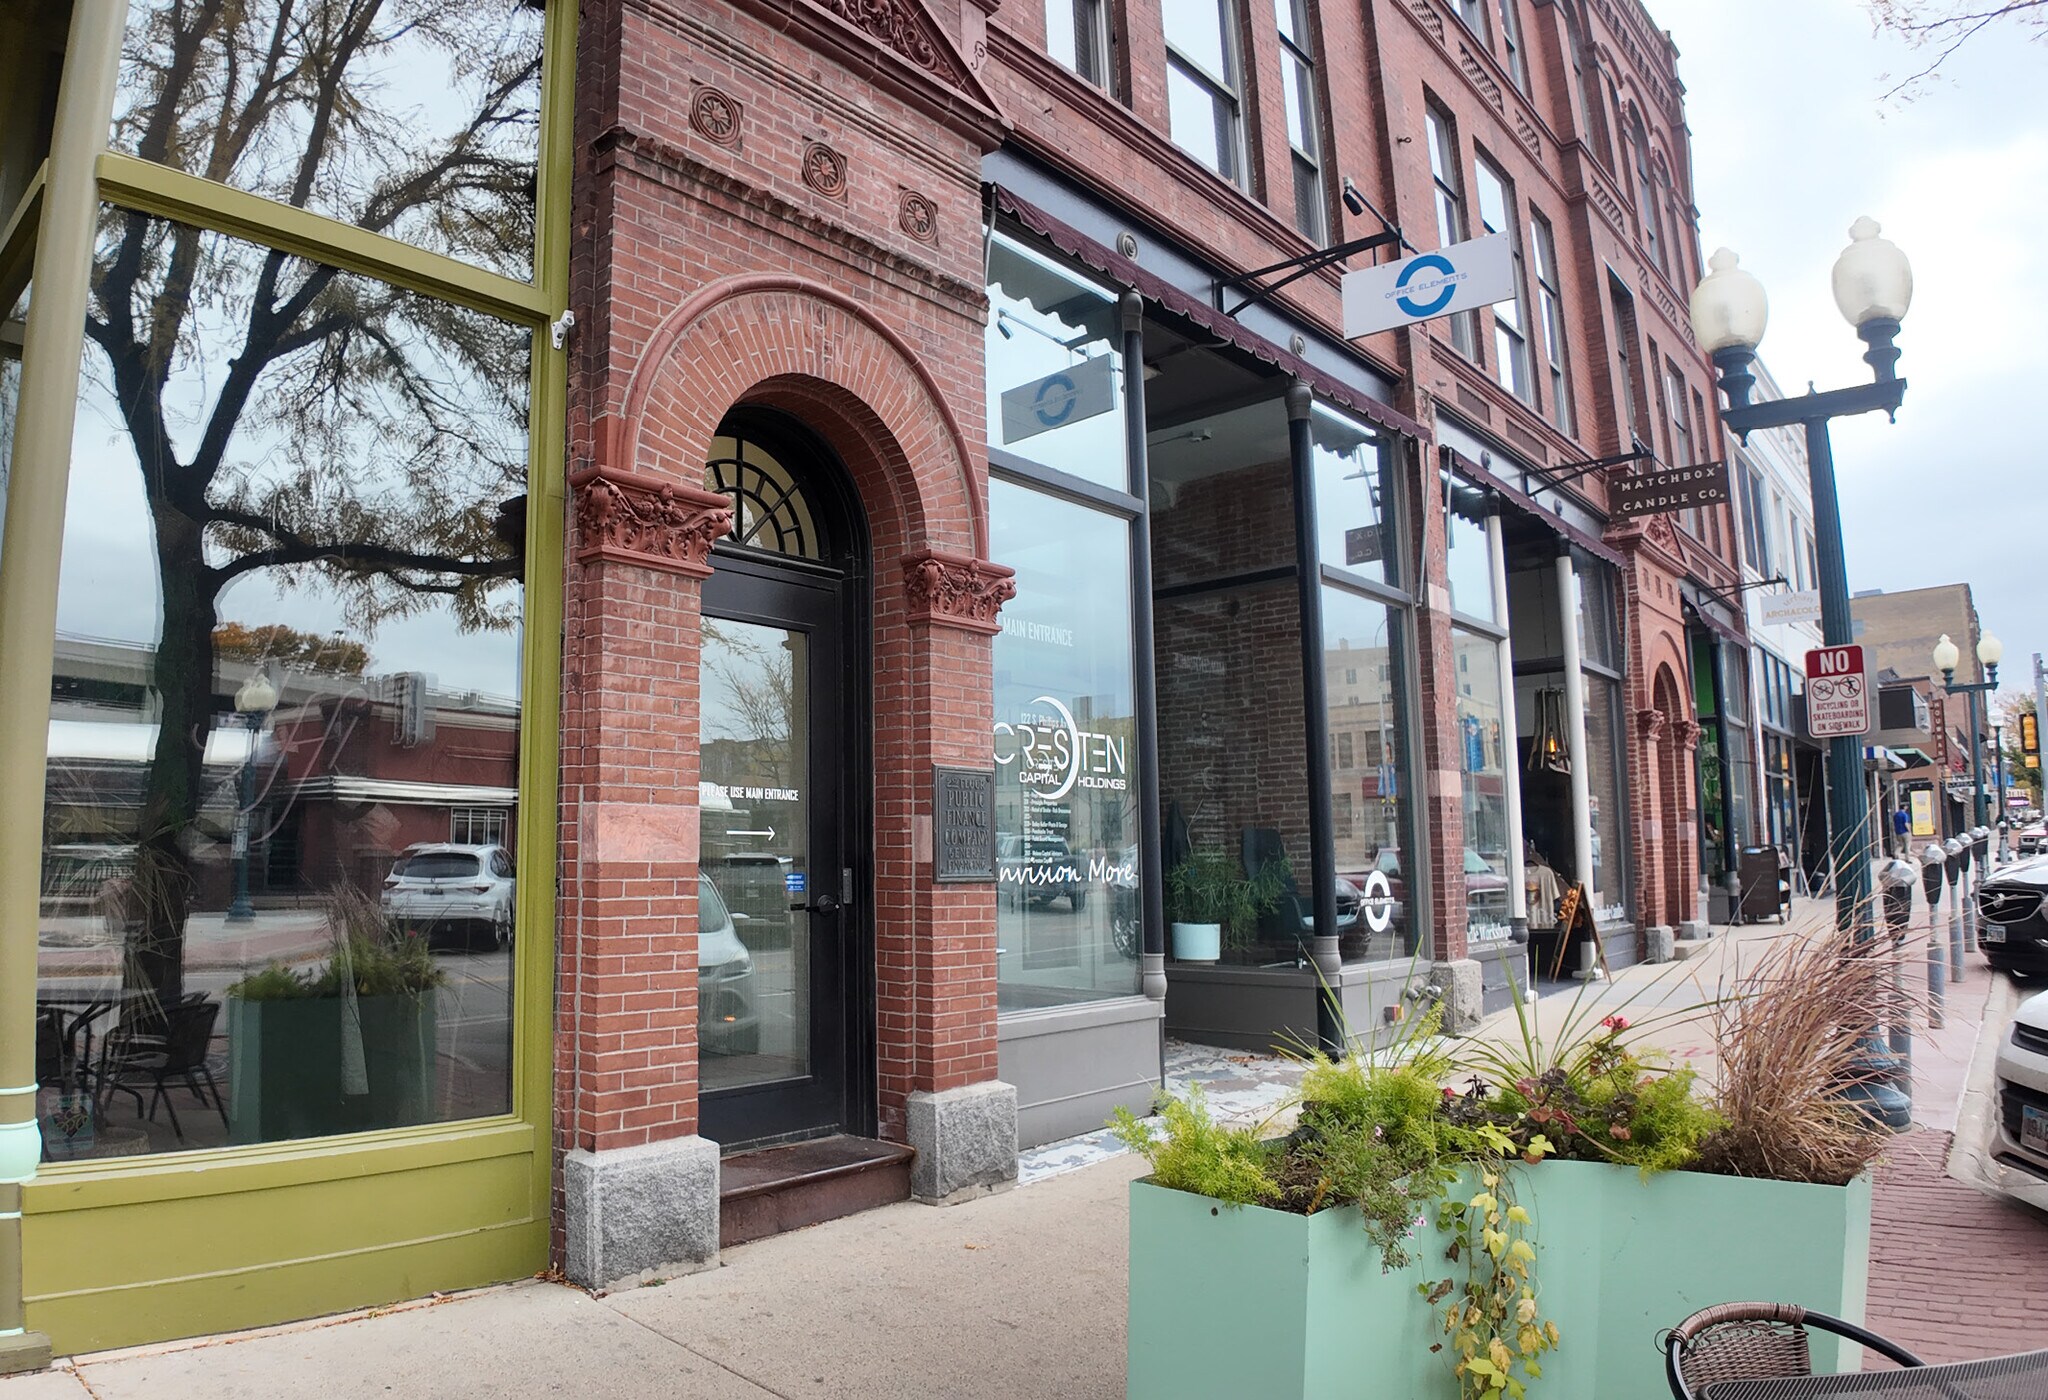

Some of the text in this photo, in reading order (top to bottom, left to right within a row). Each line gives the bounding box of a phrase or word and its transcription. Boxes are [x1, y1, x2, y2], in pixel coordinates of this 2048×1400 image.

[1384, 272, 1468, 300] OFFICE ELEMENTS
[1621, 467, 1716, 492] MATCHBOX
[1622, 493, 1688, 511] CANDLE
[1003, 616, 1073, 647] MAIN ENTRANCE
[1819, 650, 1850, 674] NO
[1816, 699, 1859, 711] BICYCLING OR
[1813, 709, 1864, 721] SKATEBOARDING
[1818, 720, 1860, 731] ON SIDEWALK
[993, 722, 1126, 775] CRESTEN
[1019, 771, 1127, 790] CAPITAL HOLDINGS
[702, 785, 799, 801] PLEASE USE MAIN ENTRANCE
[947, 790, 985, 808] PUBLIC
[945, 809, 987, 827] FINANCE
[944, 828, 990, 847] COMPANY
[948, 846, 987, 859] GENERAL
[998, 856, 1136, 886] nvision More
